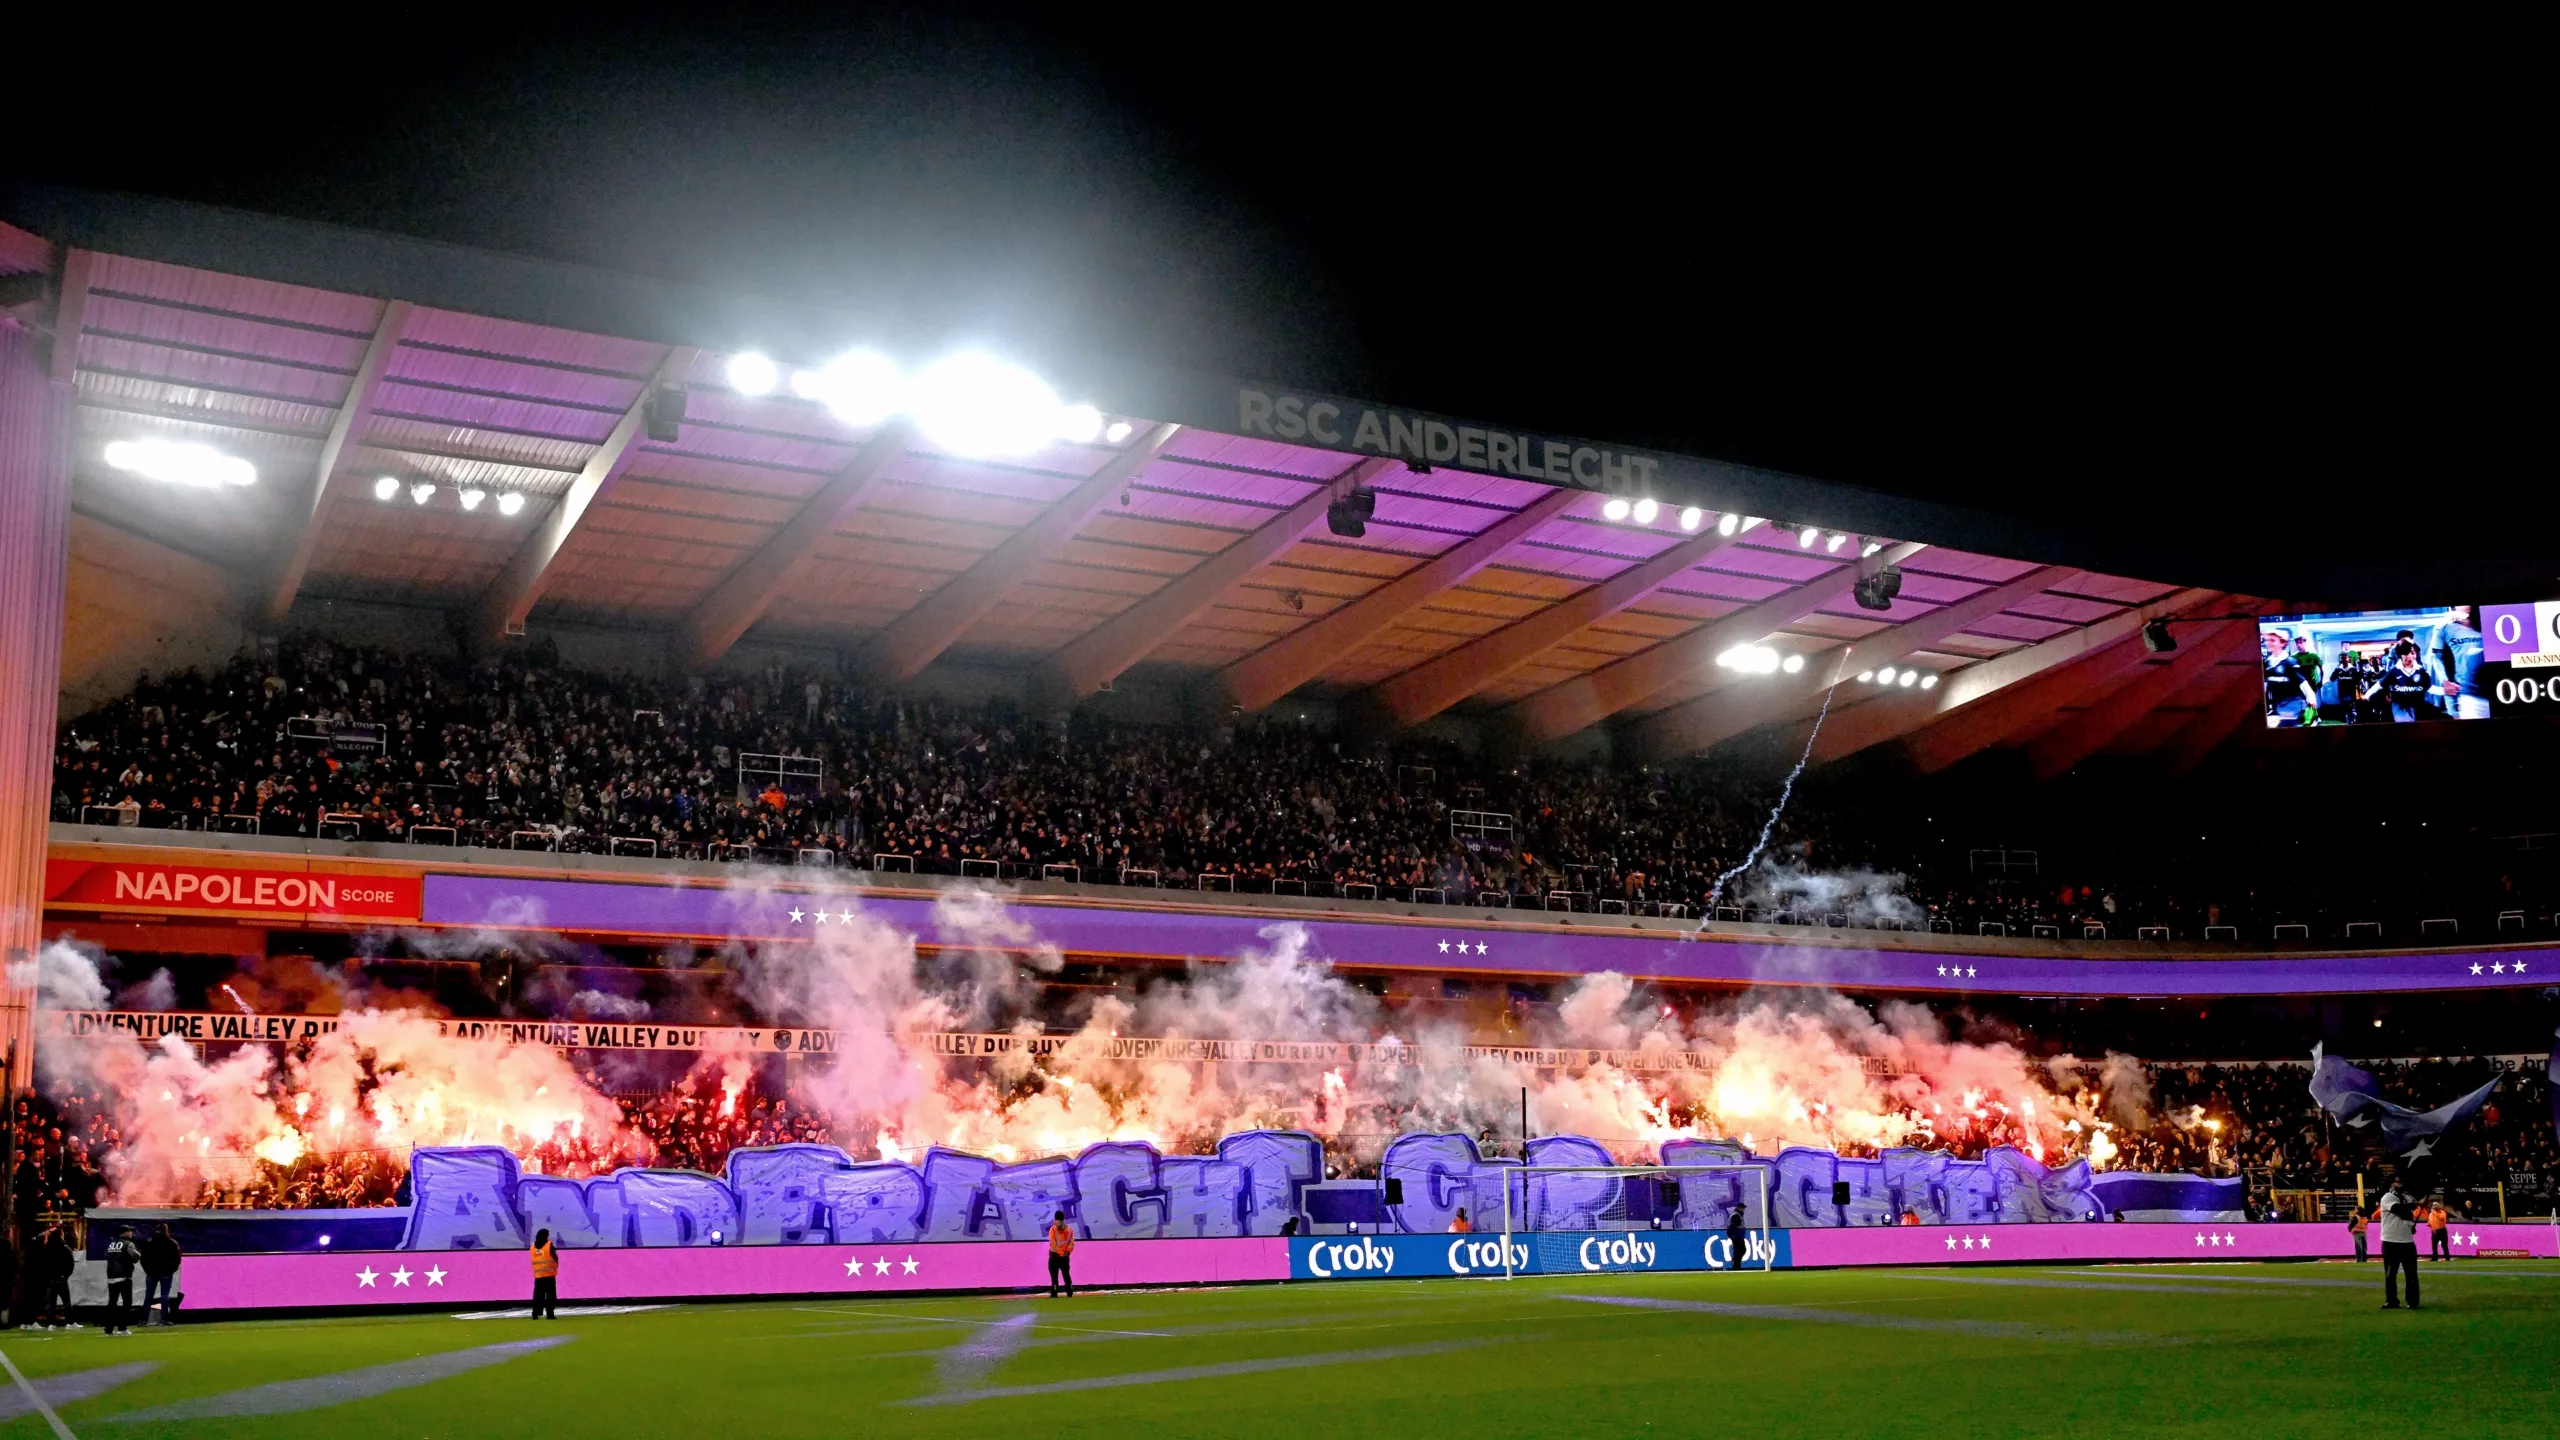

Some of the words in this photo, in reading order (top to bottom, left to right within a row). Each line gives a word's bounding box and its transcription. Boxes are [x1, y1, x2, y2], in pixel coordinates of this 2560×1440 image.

[1239, 389, 1341, 444] RSC
[1352, 409, 1659, 494] ANDERLECHT
[2494, 614, 2521, 644] 0
[115, 870, 336, 908] NAPOLEON
[341, 888, 394, 903] SCORE
[211, 1016, 296, 1040] VALLEY
[585, 1025, 660, 1048] VALLEY
[1264, 1044, 1337, 1060] DURBUY
[1606, 1051, 1683, 1070] ADVENURE
[2510, 1173, 2537, 1184] SEPPE
[1308, 1237, 1394, 1277] Croky
[1448, 1235, 1529, 1274] Croky
[1580, 1233, 1656, 1270] Croky
